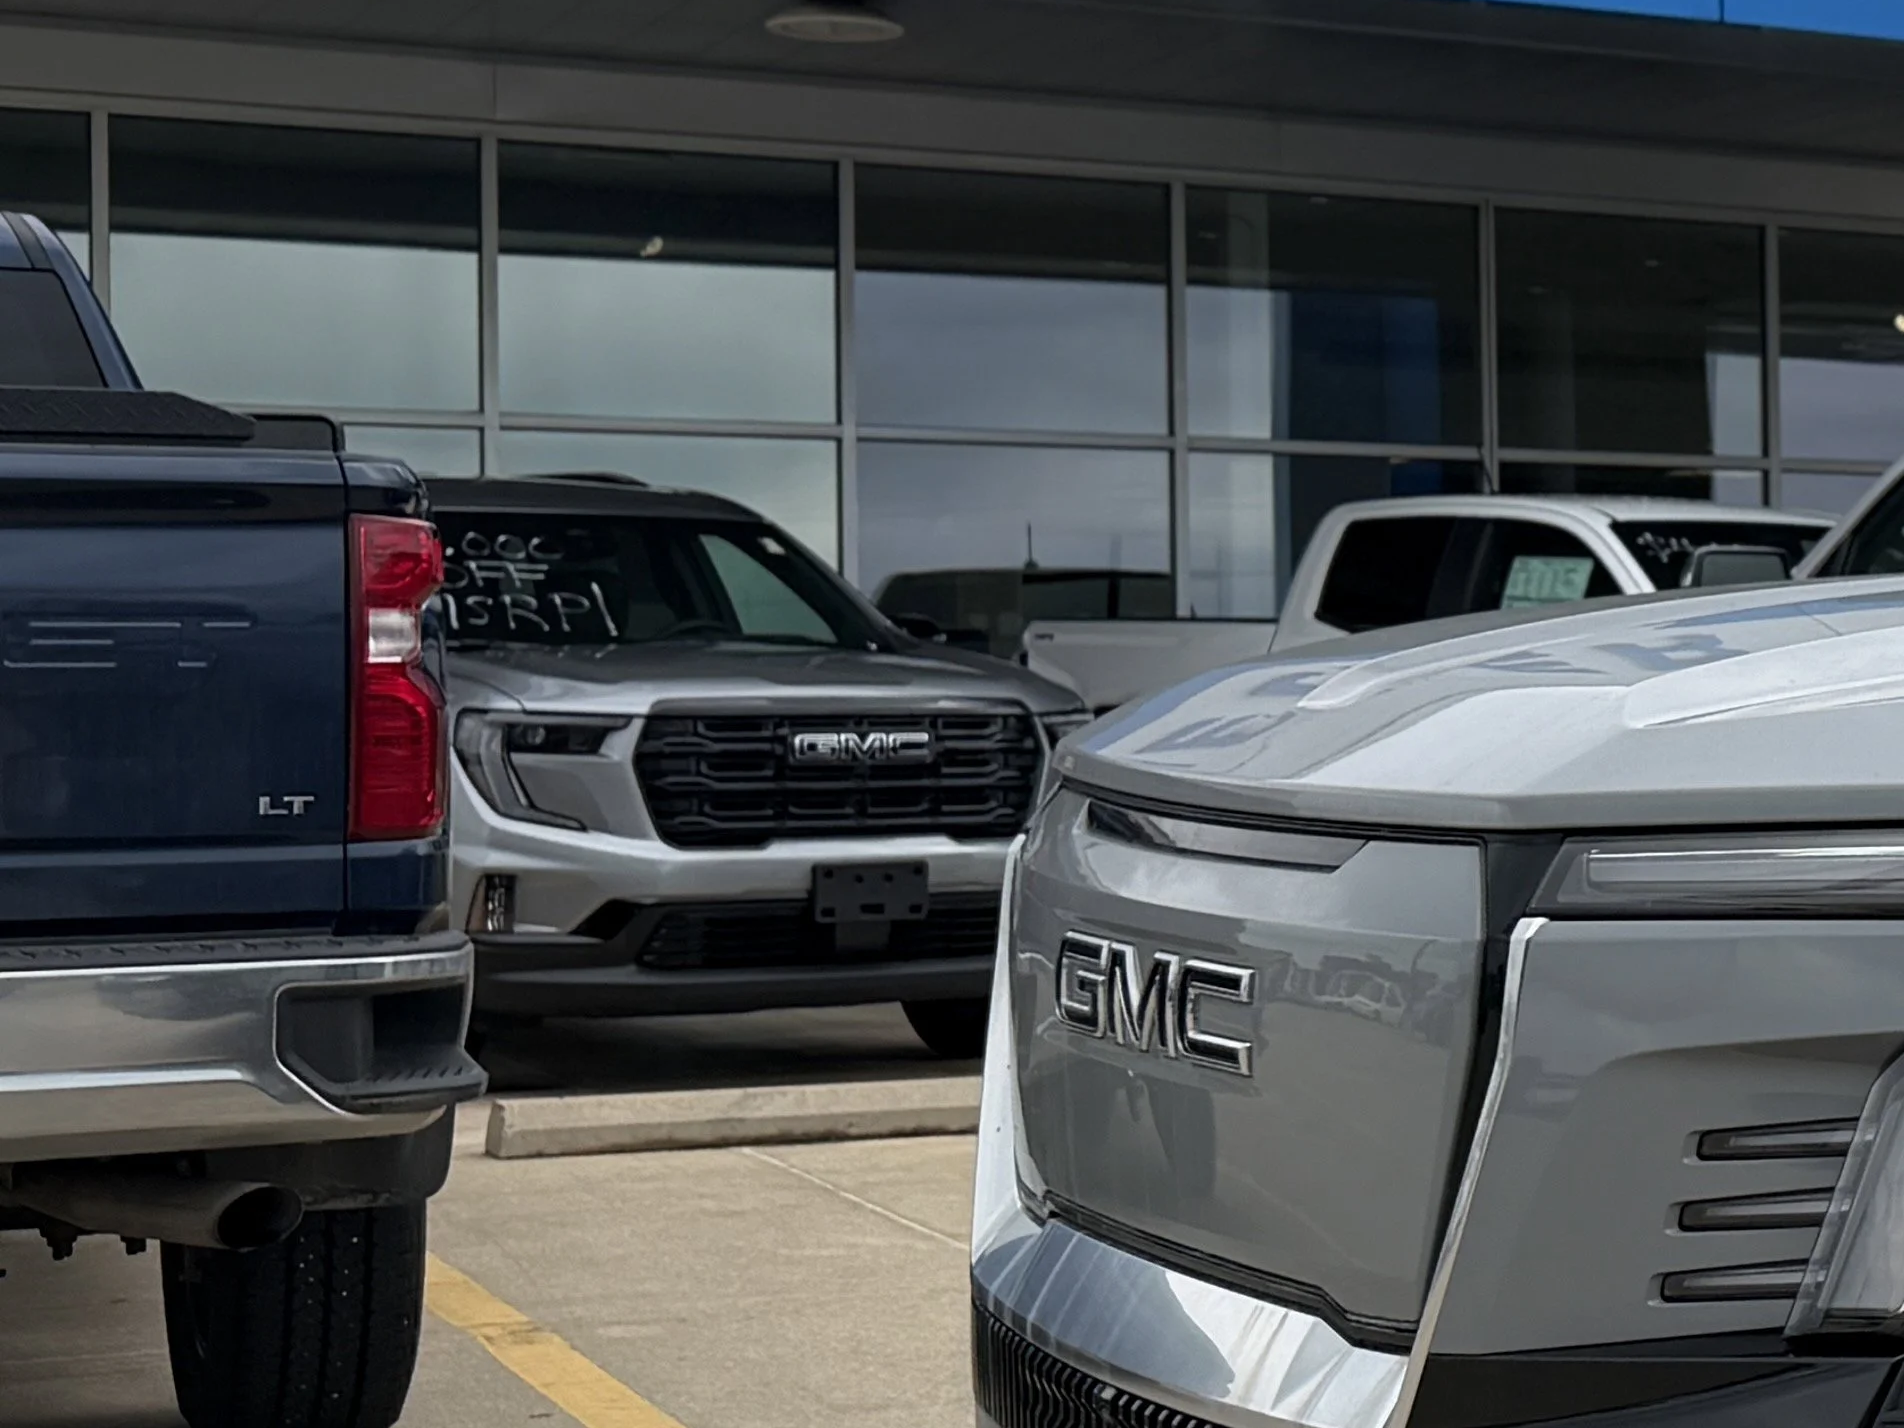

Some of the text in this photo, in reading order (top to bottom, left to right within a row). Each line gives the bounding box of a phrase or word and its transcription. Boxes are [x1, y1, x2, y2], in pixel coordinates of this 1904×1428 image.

[794, 732, 930, 762] GMC
[259, 795, 315, 815] LT
[1055, 929, 1256, 1077] GMC
